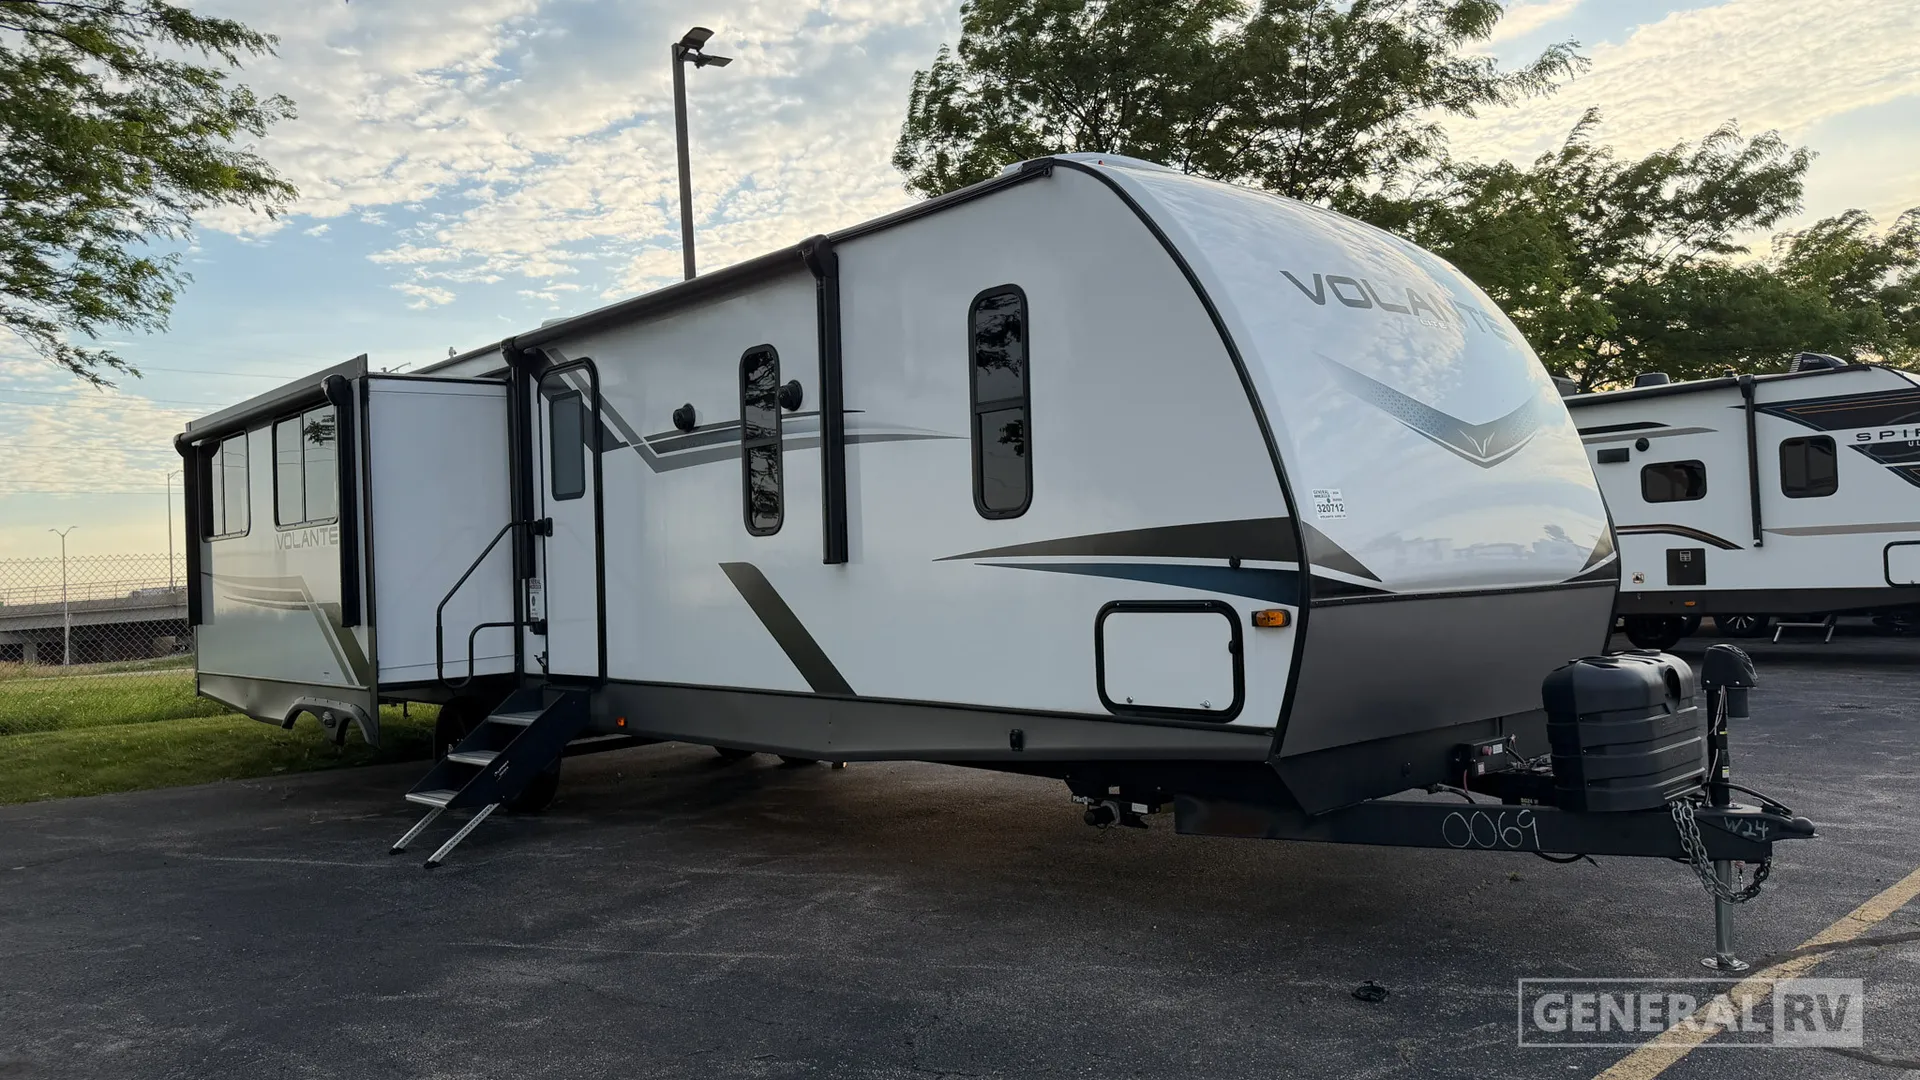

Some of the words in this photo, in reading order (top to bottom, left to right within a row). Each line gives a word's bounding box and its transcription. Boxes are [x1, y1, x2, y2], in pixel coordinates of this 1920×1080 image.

[1279, 270, 1515, 345] VOLANTE
[1316, 503, 1345, 513] 320712
[276, 526, 338, 550] VOLANTE
[1442, 809, 1540, 848] 0069
[1723, 816, 1769, 841] W24
